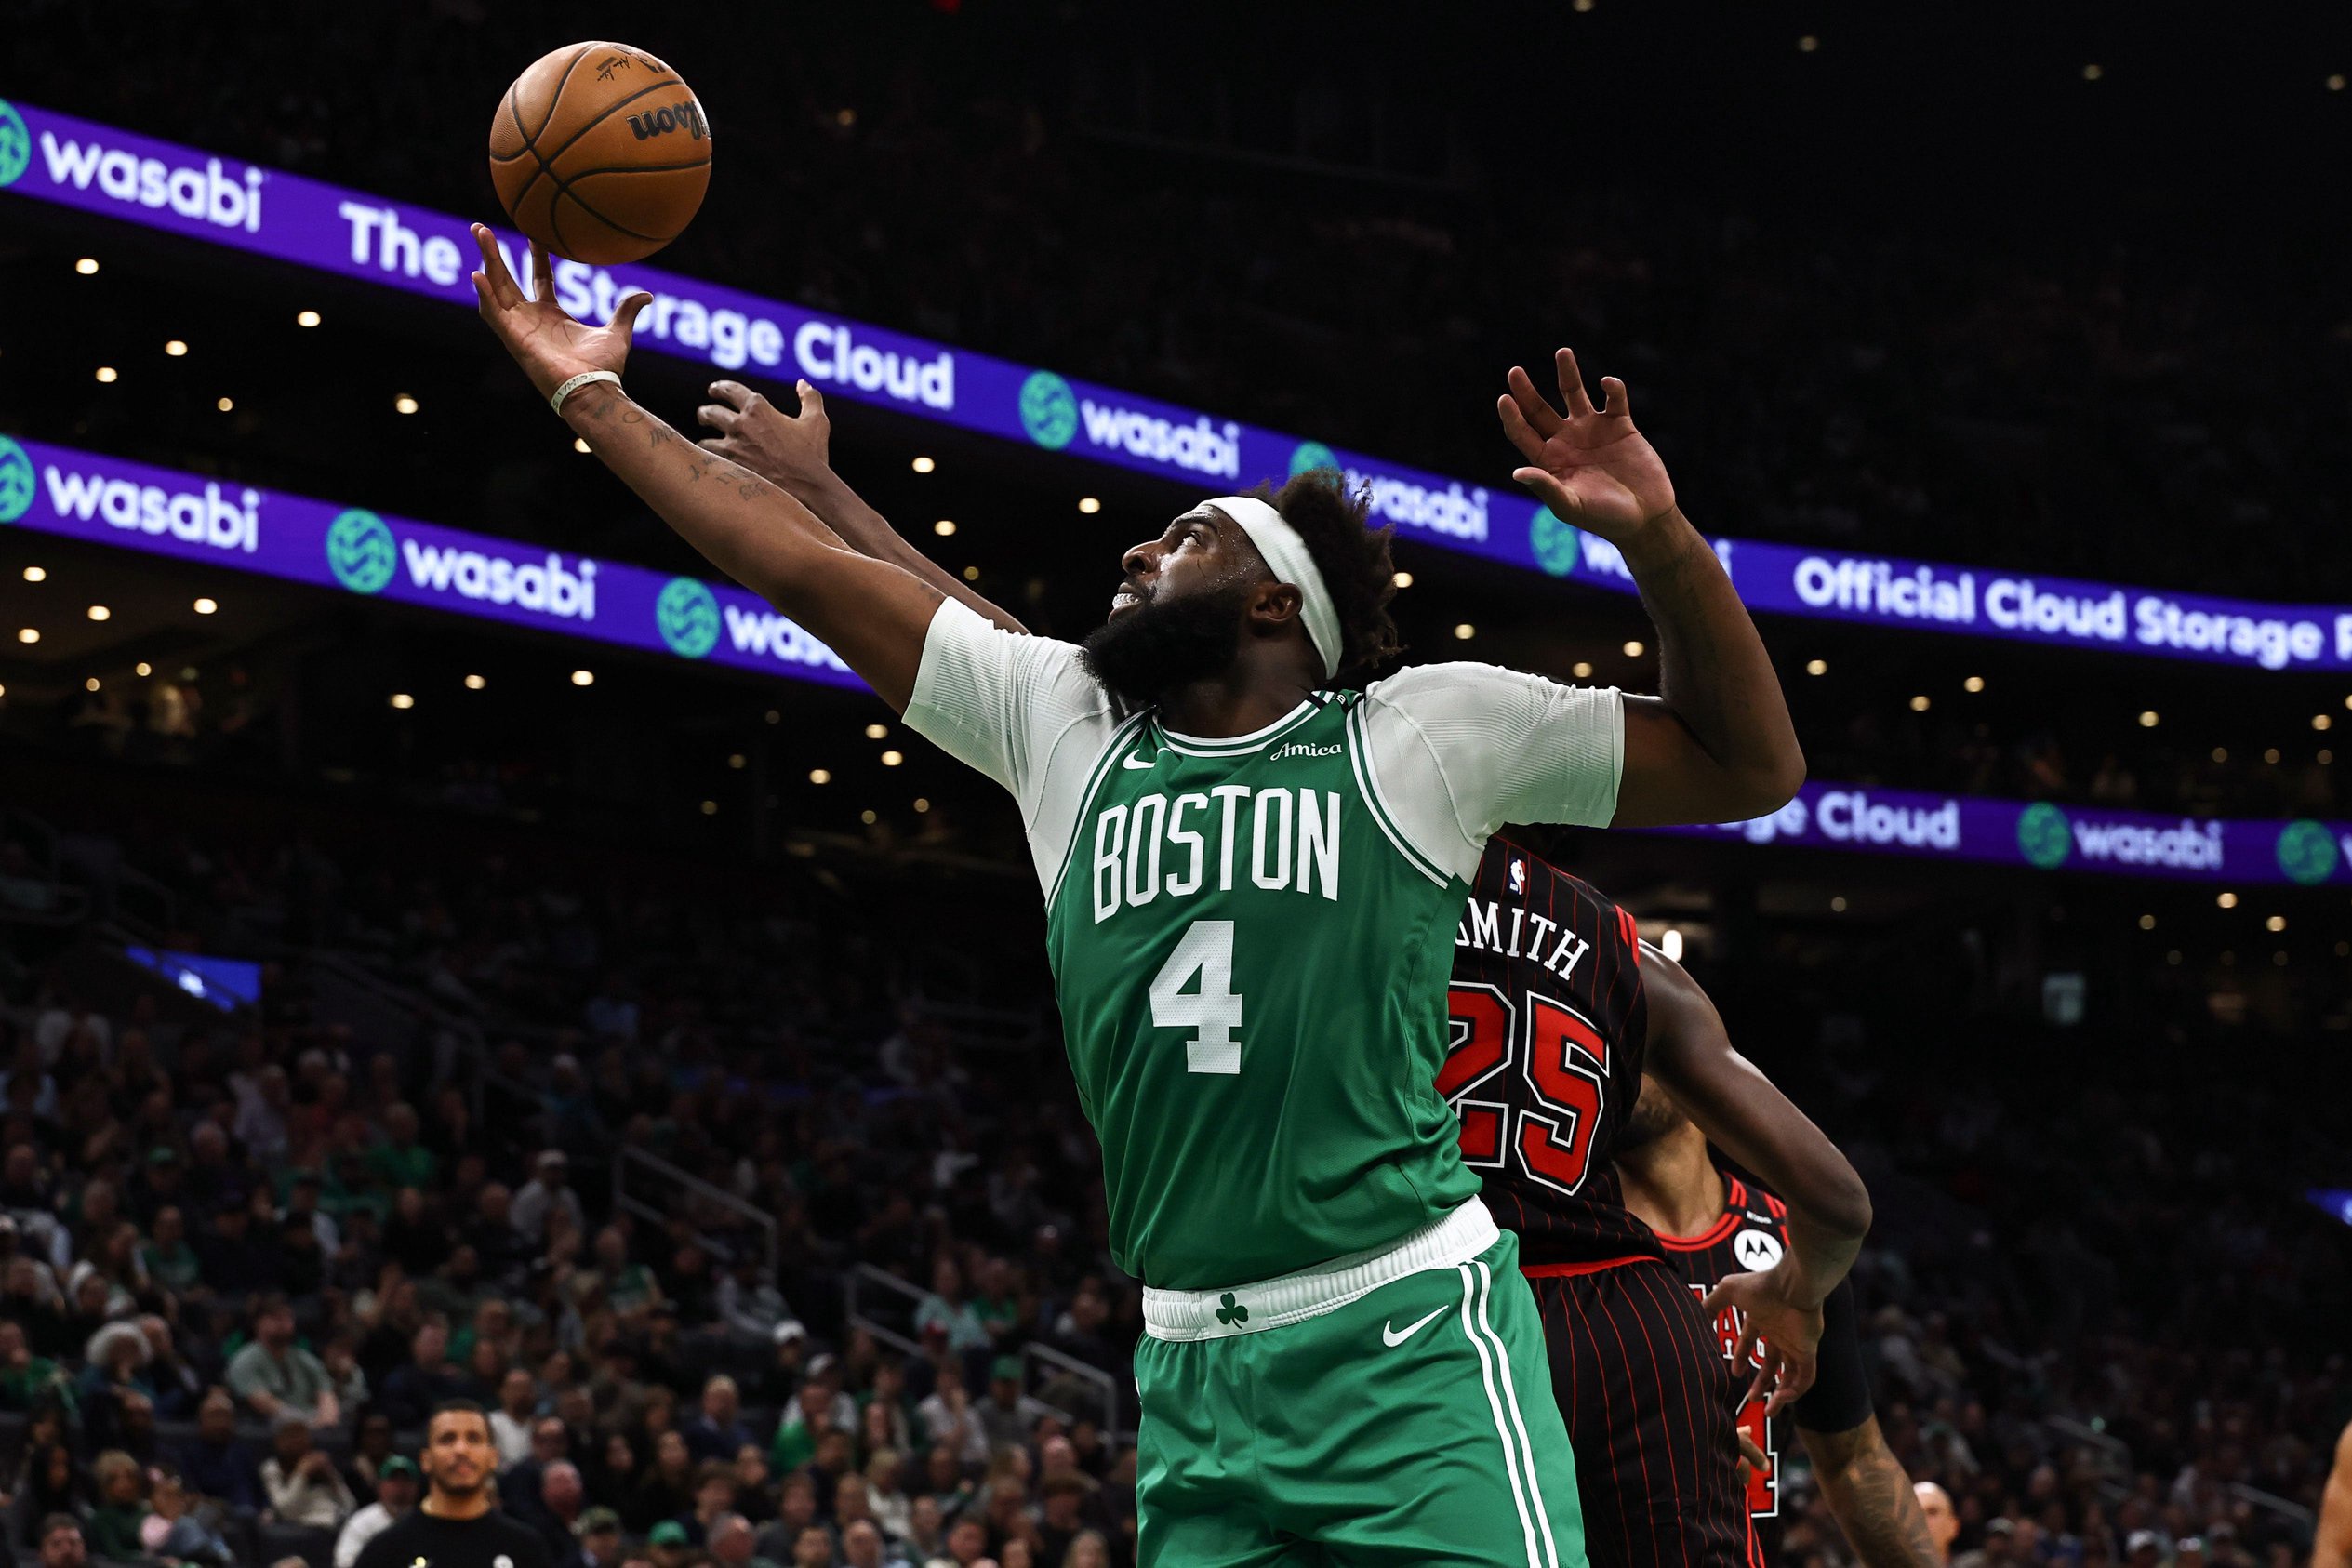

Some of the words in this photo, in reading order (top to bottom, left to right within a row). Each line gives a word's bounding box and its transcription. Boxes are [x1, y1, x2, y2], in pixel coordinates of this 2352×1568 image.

[625, 100, 711, 141] lson
[41, 132, 263, 233] wasabi
[339, 201, 462, 286] The
[794, 321, 954, 411] Cloud
[1081, 399, 1240, 477] wasabi
[45, 466, 260, 553] wasabi
[403, 538, 597, 620] wasabi
[1793, 556, 1977, 622] Official
[1984, 578, 2127, 641] Cloud
[2134, 596, 2325, 670] Storage
[1269, 741, 1343, 762] Amica
[1093, 784, 1341, 925] BOSTON
[1816, 791, 1960, 848] Cloud
[2074, 819, 2223, 869] wasabi
[1149, 920, 1242, 1074] 4
[1433, 980, 1610, 1197] 25
